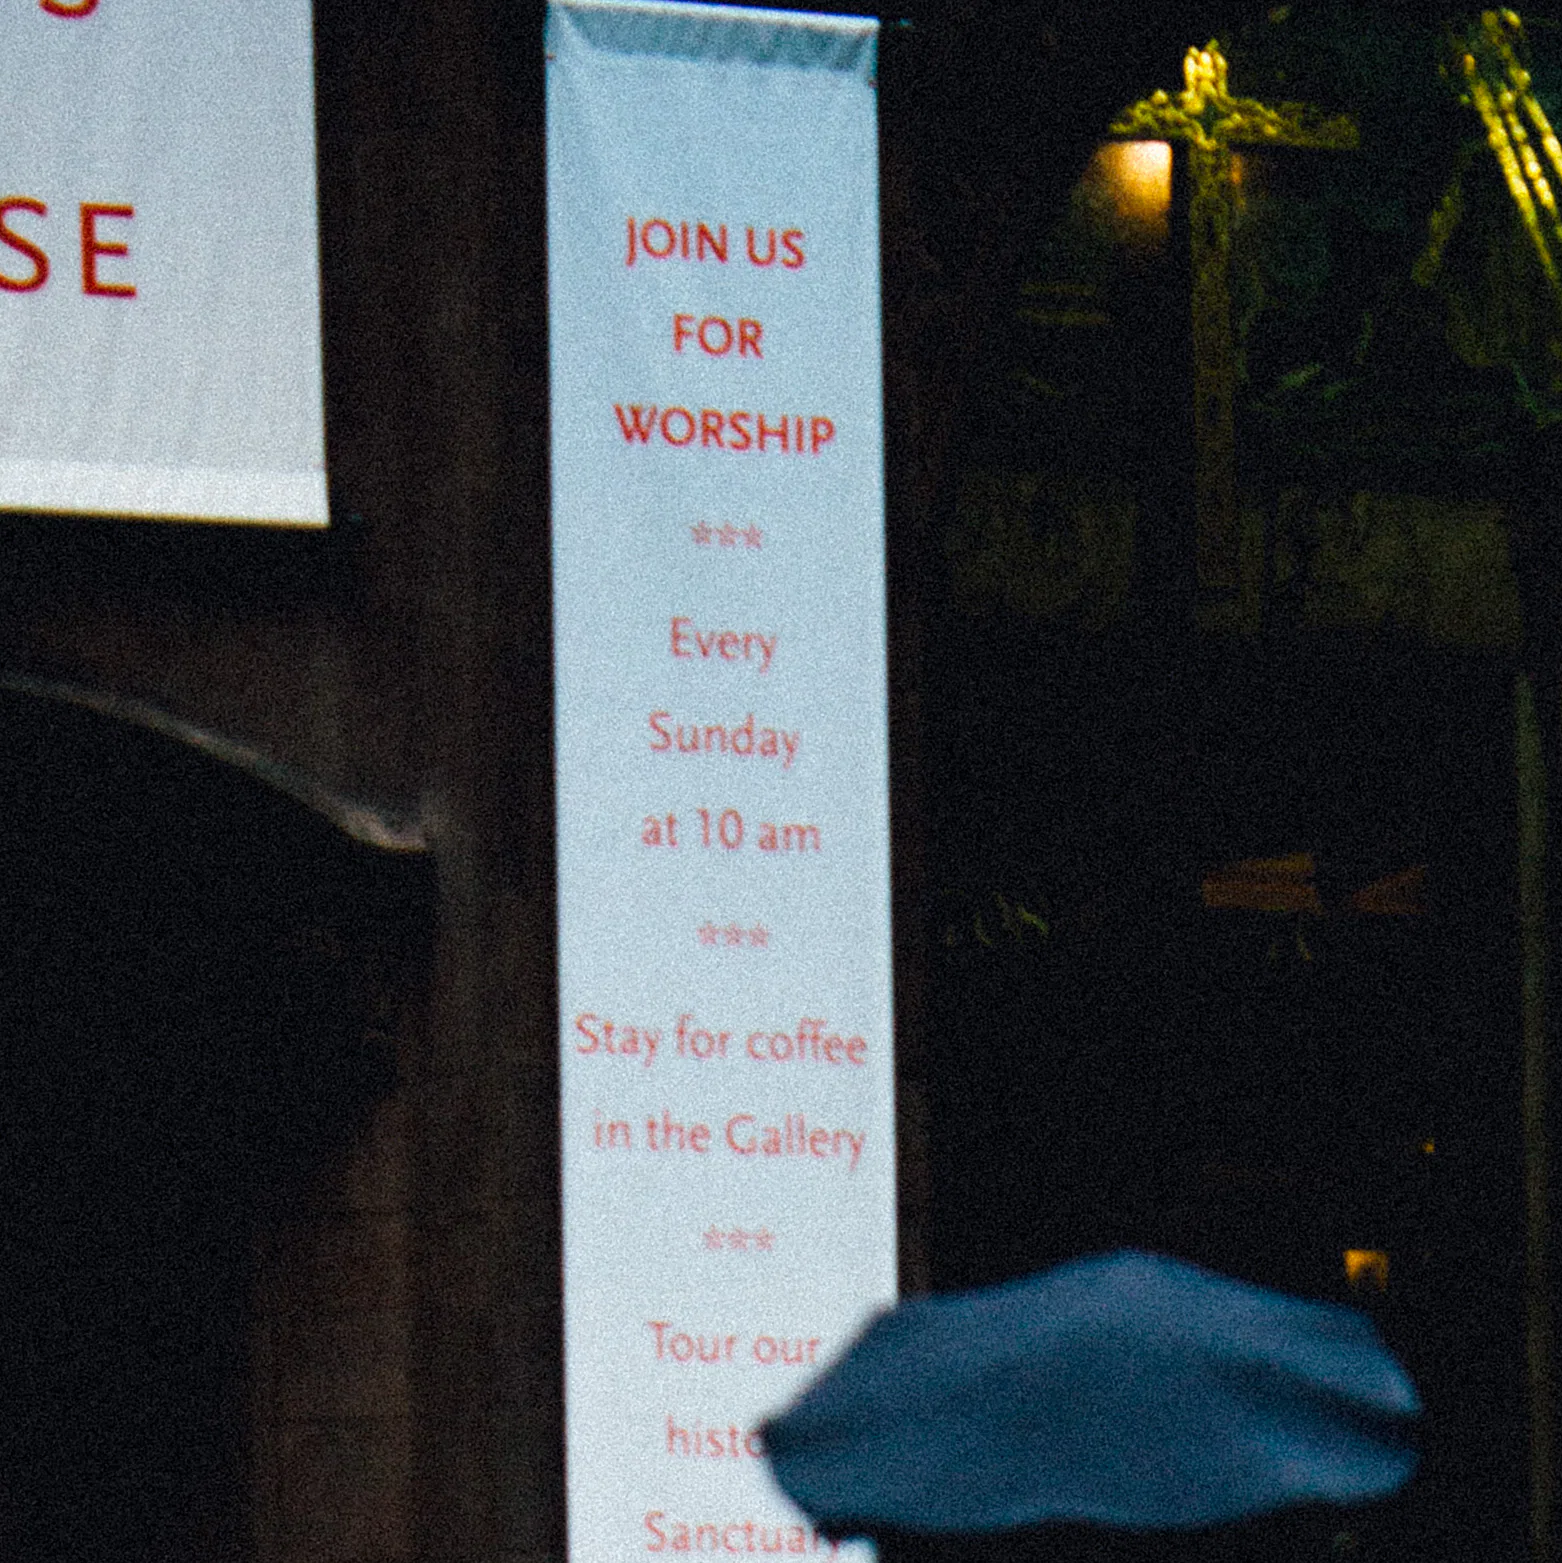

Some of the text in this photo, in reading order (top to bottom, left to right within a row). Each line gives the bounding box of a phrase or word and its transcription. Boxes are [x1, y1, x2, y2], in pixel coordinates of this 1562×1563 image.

[625, 217, 806, 271] JOIN US
[672, 313, 764, 358] FOR
[613, 404, 836, 455] WORSHIP
[669, 616, 777, 674] Every
[648, 709, 800, 769] Sunday
[641, 807, 821, 852] at 10 am
[574, 1012, 867, 1066] Stay for coffee
[594, 1109, 864, 1171] in the Gallery
[648, 1319, 820, 1366] Tour our
[666, 1416, 760, 1458] histo
